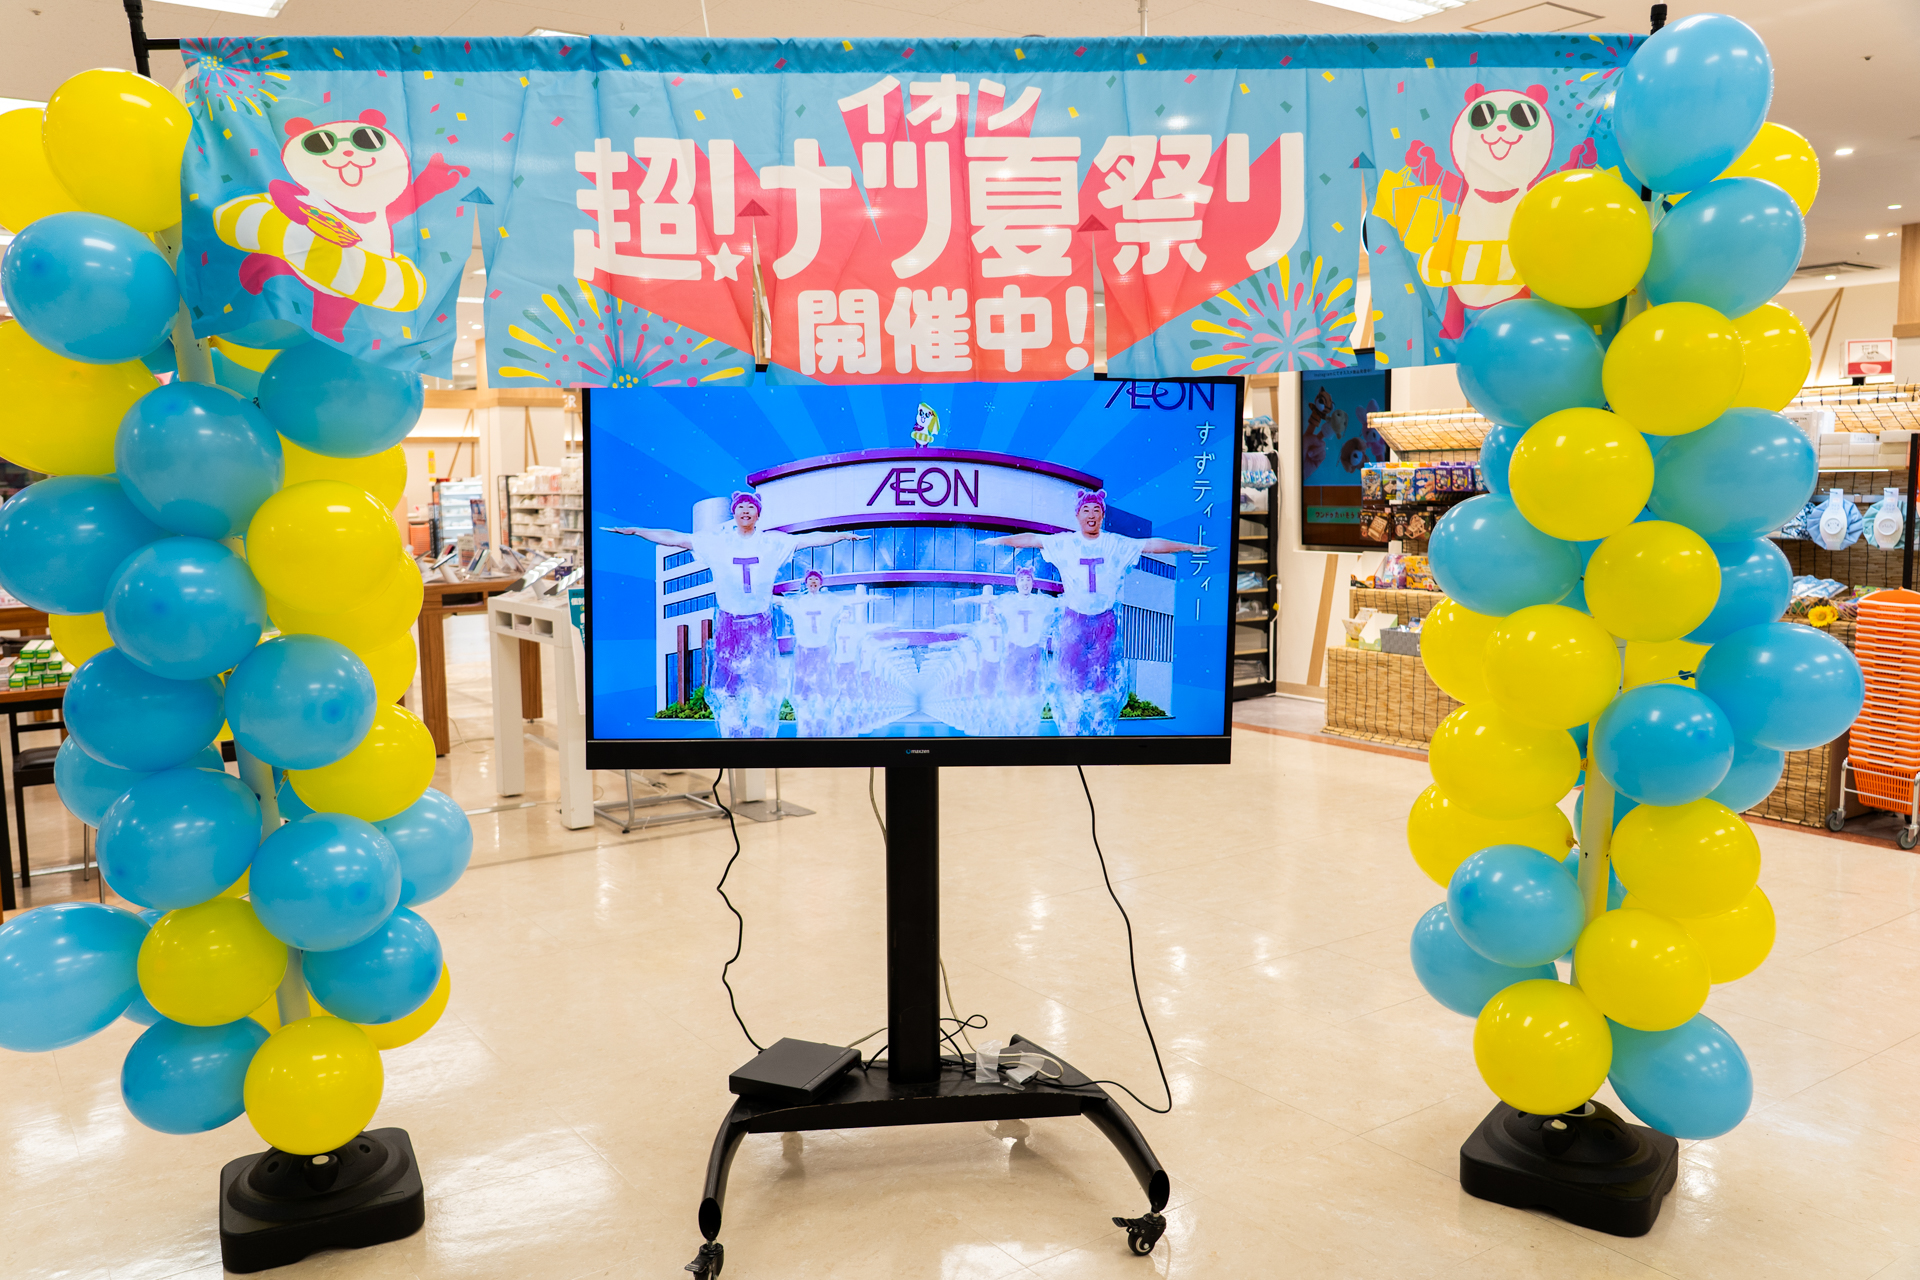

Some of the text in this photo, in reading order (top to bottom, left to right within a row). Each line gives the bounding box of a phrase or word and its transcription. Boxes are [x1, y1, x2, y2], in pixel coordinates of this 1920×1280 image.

[837, 73, 1042, 135] イオン
[797, 284, 1091, 375] 開催中!
[732, 556, 760, 593] T
[1079, 557, 1105, 593] T
[805, 610, 822, 634] T
[1017, 610, 1033, 633] T
